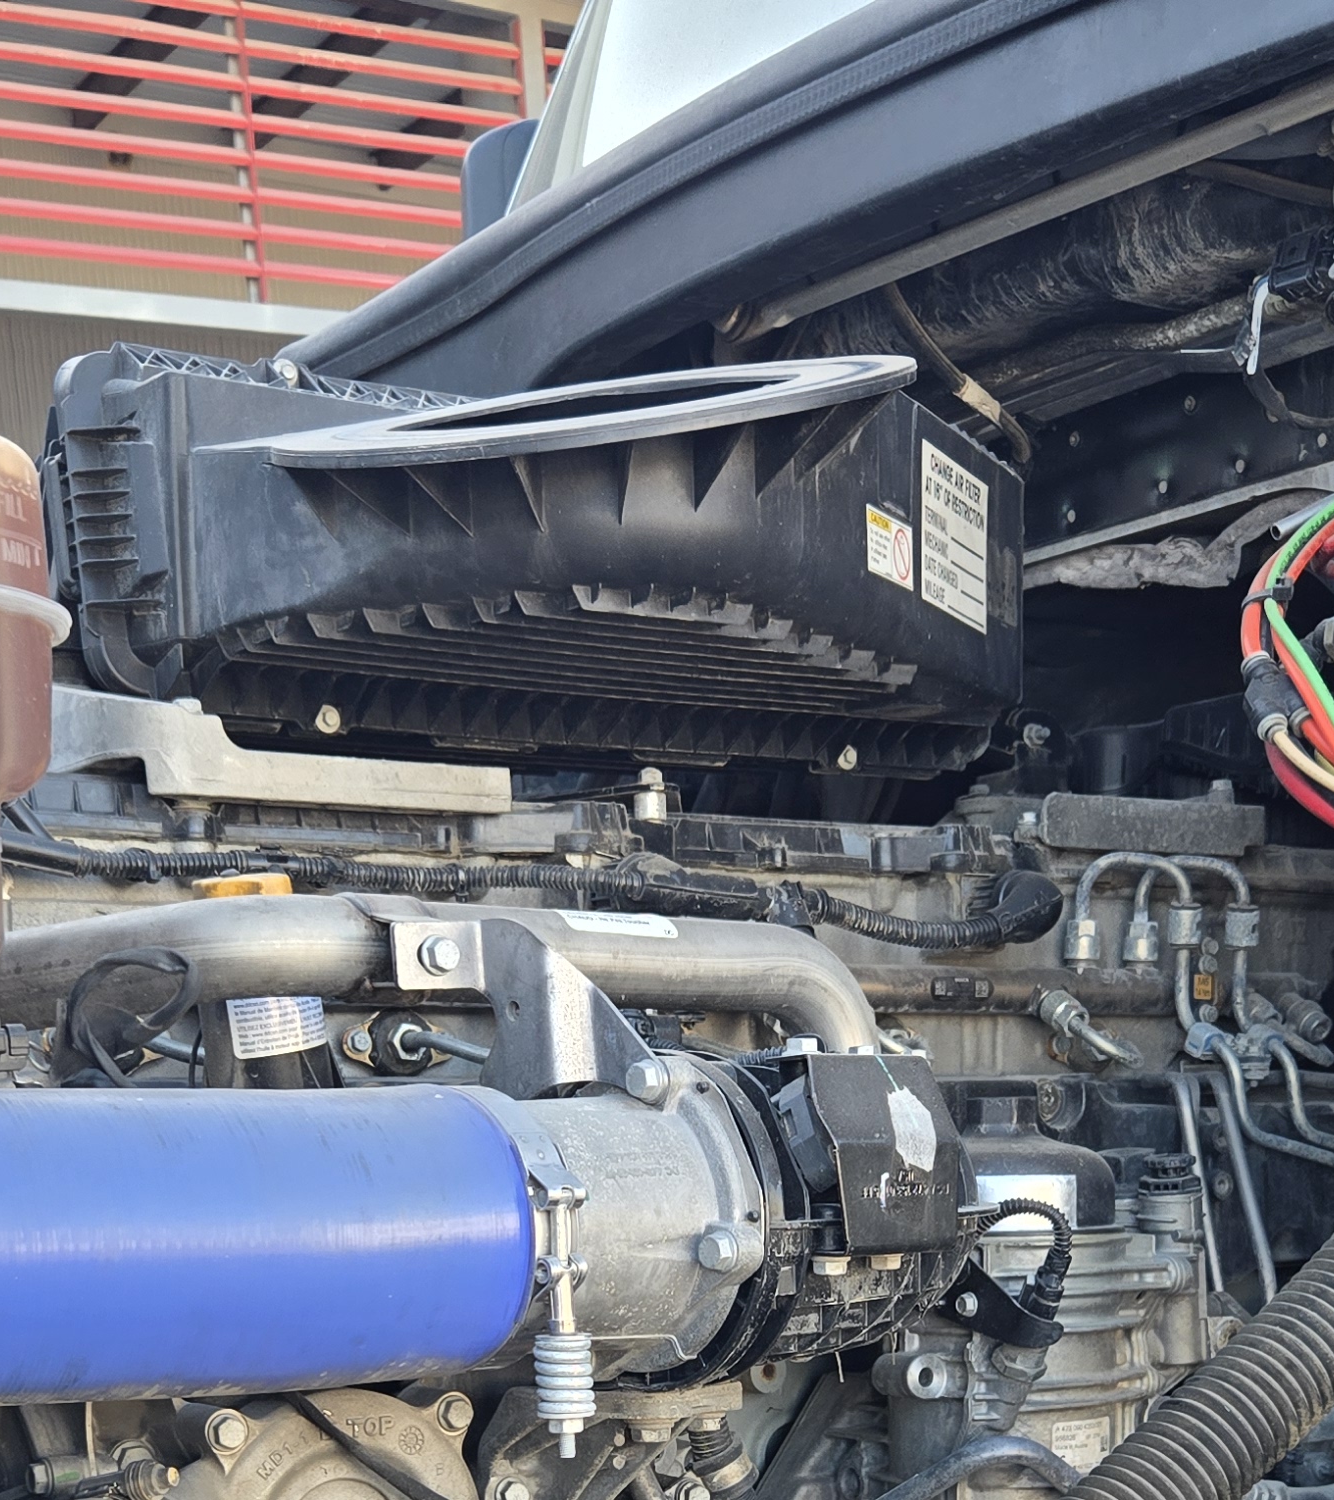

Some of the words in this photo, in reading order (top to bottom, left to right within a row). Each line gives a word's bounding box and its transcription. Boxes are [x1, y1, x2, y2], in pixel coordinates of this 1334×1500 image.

[925, 474, 932, 496] AT
[944, 488, 951, 509] OF
[952, 492, 985, 533] RESTRICTION
[931, 453, 953, 486] CHANGE
[954, 471, 964, 494] AIR
[965, 479, 981, 506] FILTER
[346, 1414, 396, 1438] TOP
